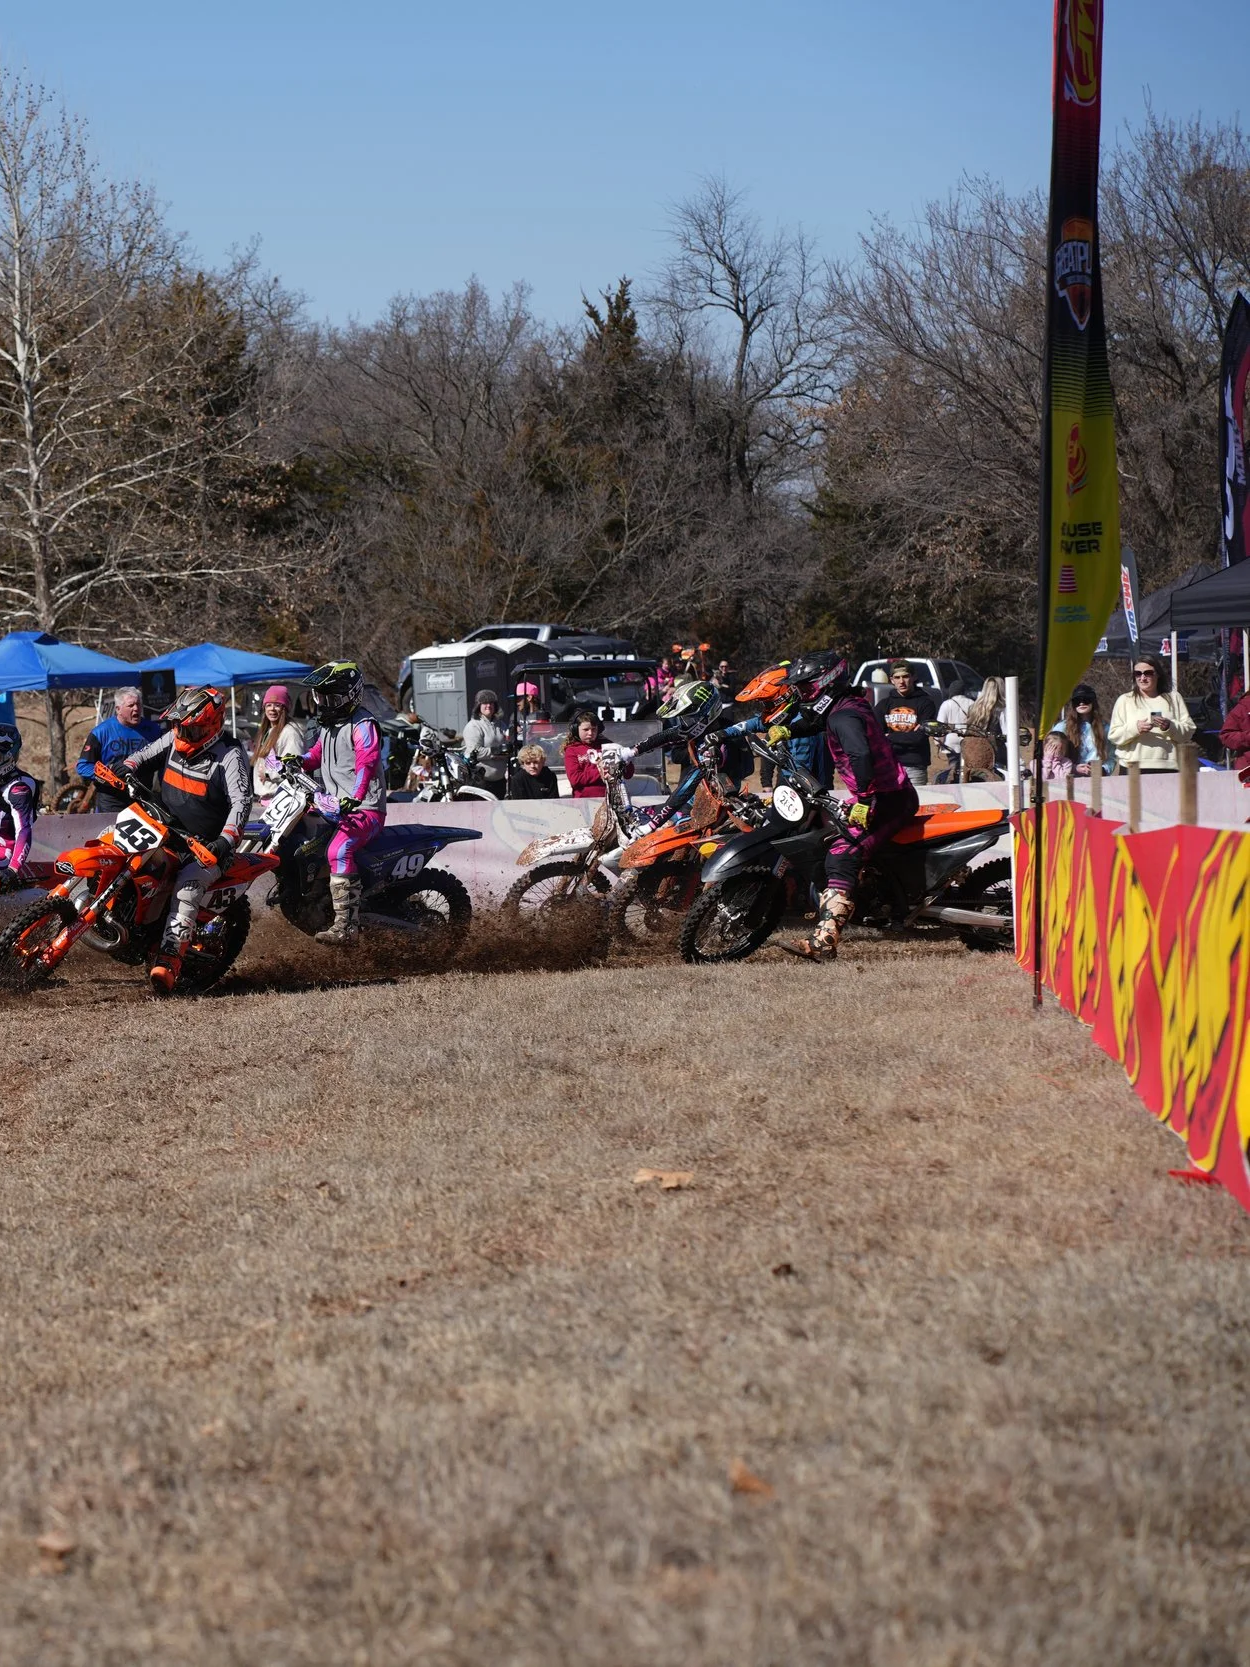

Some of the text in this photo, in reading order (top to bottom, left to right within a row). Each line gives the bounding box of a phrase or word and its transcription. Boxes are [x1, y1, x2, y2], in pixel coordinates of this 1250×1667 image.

[1120, 564, 1139, 643] AMSOIL
[654, 805, 672, 824] FXR
[116, 818, 158, 851] 43
[391, 853, 425, 879] 49
[207, 887, 237, 909] 43
